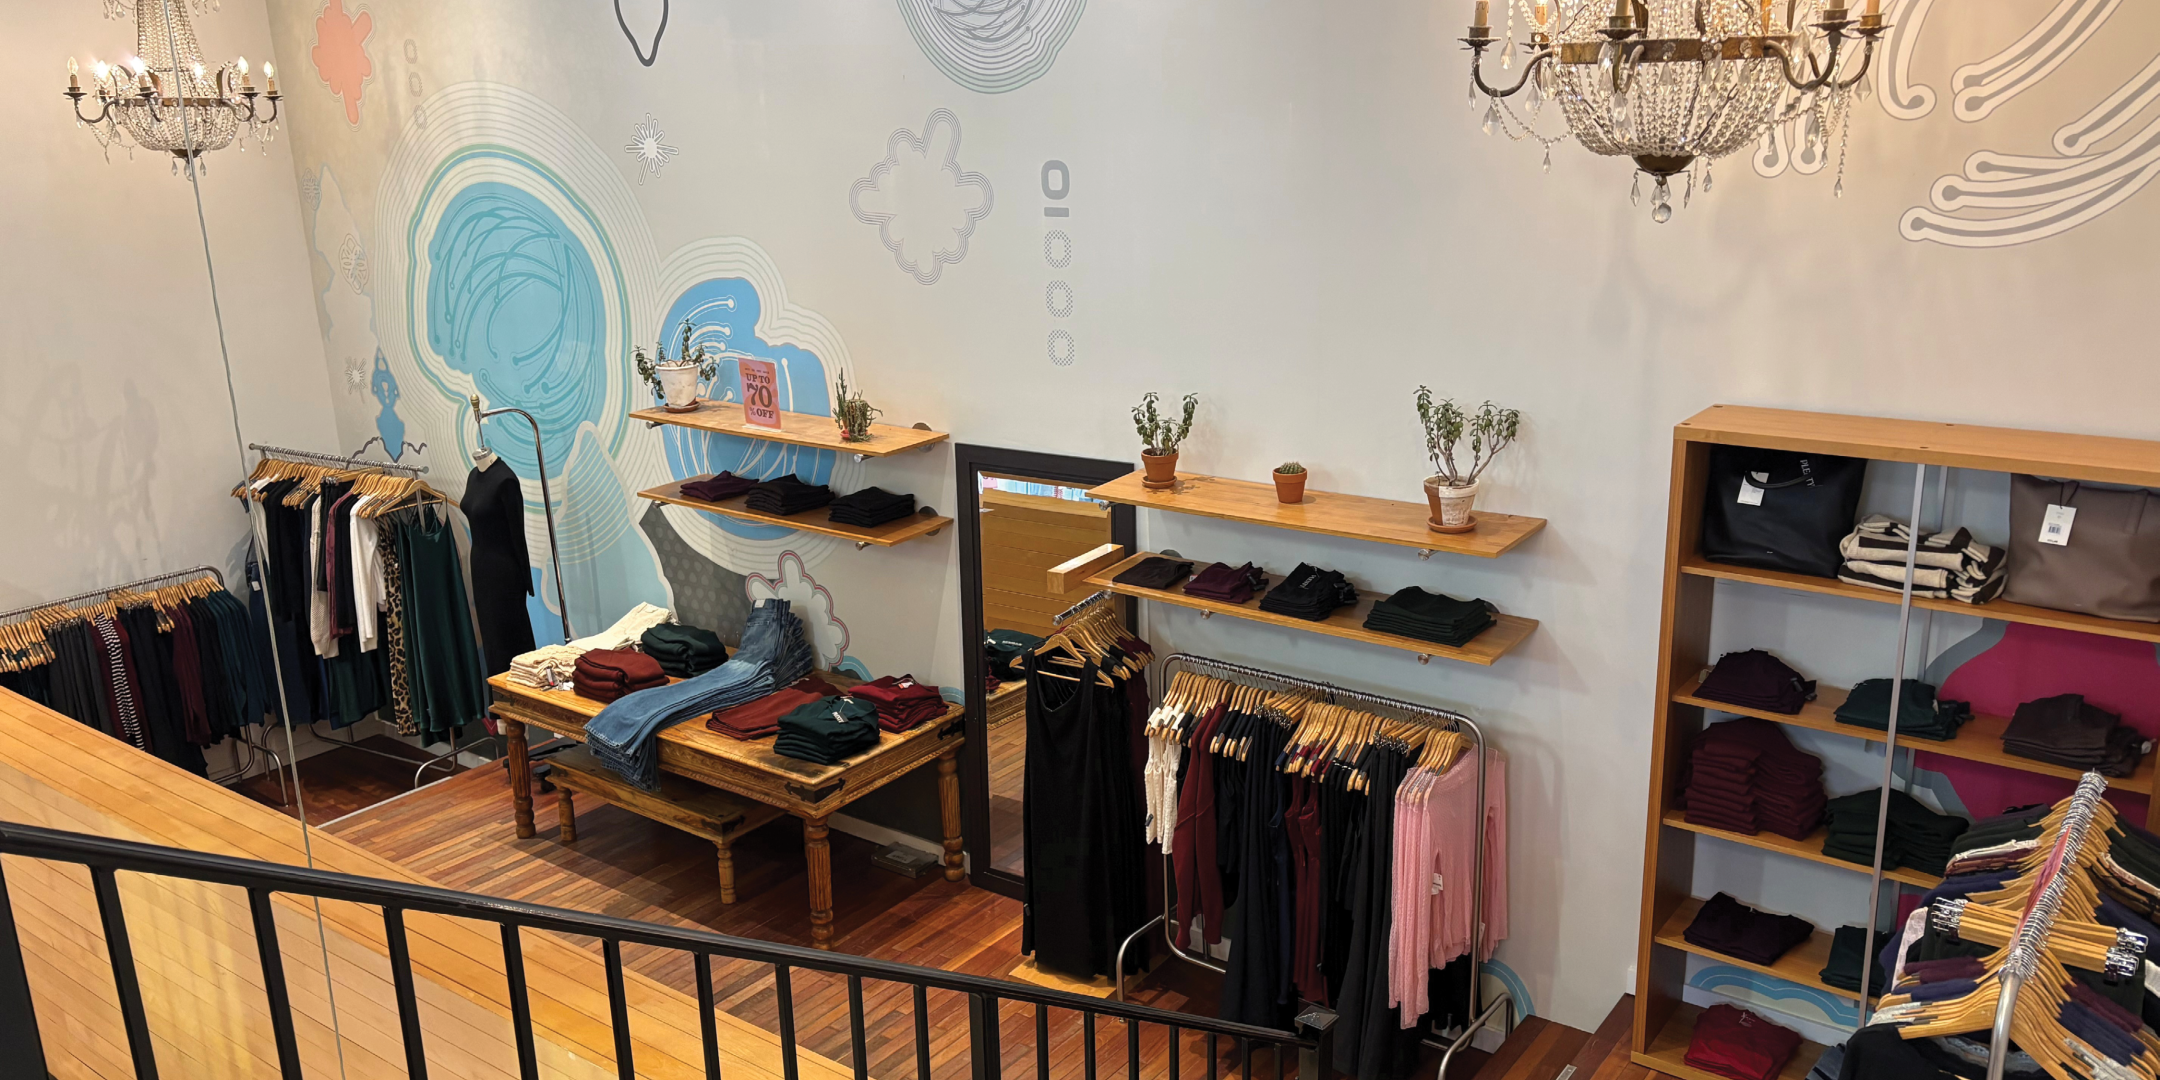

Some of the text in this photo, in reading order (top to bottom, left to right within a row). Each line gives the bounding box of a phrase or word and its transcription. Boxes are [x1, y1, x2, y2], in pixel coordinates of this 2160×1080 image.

[746, 373, 770, 384] UP TO
[746, 383, 772, 408] 70
[1800, 459, 1816, 487] PLETY
